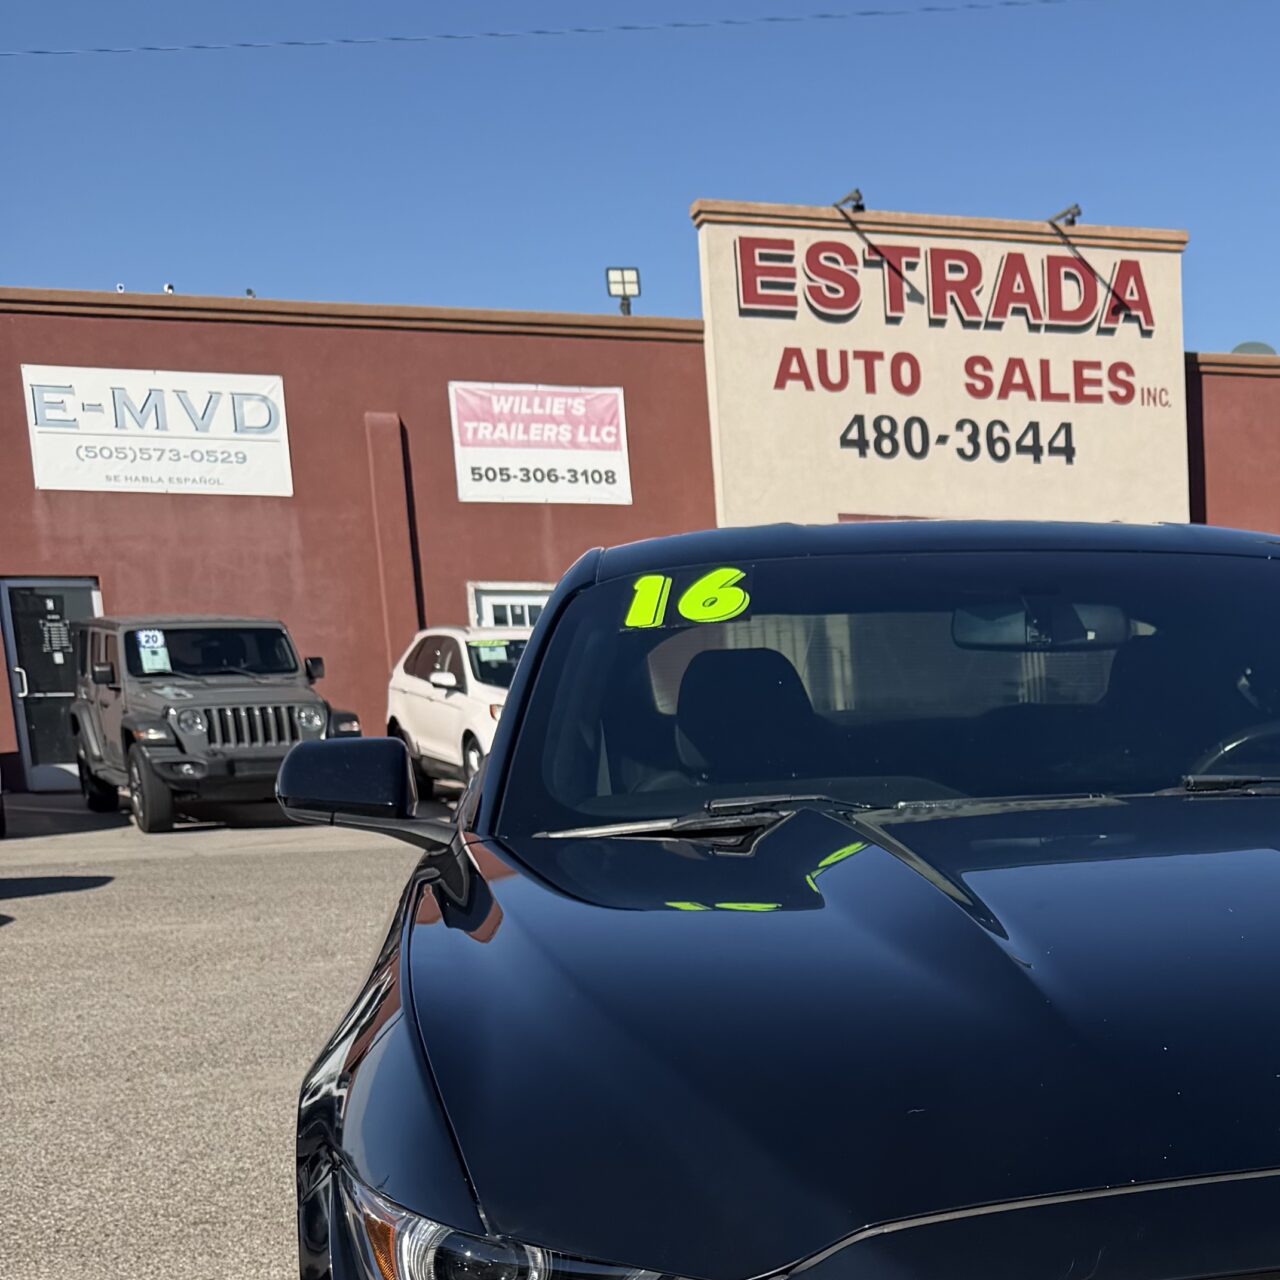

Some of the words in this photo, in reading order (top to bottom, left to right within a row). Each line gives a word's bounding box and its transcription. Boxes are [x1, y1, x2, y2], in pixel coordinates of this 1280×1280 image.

[735, 235, 1155, 338] ESTRADA
[773, 346, 921, 397] AUTO
[965, 354, 1136, 405] SALES
[30, 384, 280, 434] E-MVD
[490, 395, 586, 416] WILLIE'S
[464, 421, 572, 443] TRAILERS
[576, 426, 617, 444] LLC
[840, 413, 1076, 465] 480-3644
[75, 445, 248, 464] (505)573-0529
[105, 474, 120, 482] SE
[124, 474, 164, 484] HABLA
[168, 474, 225, 486] ESPAÑOL
[470, 466, 617, 485] 505-306-3108
[624, 567, 751, 628] 16
[144, 634, 159, 644] 20
